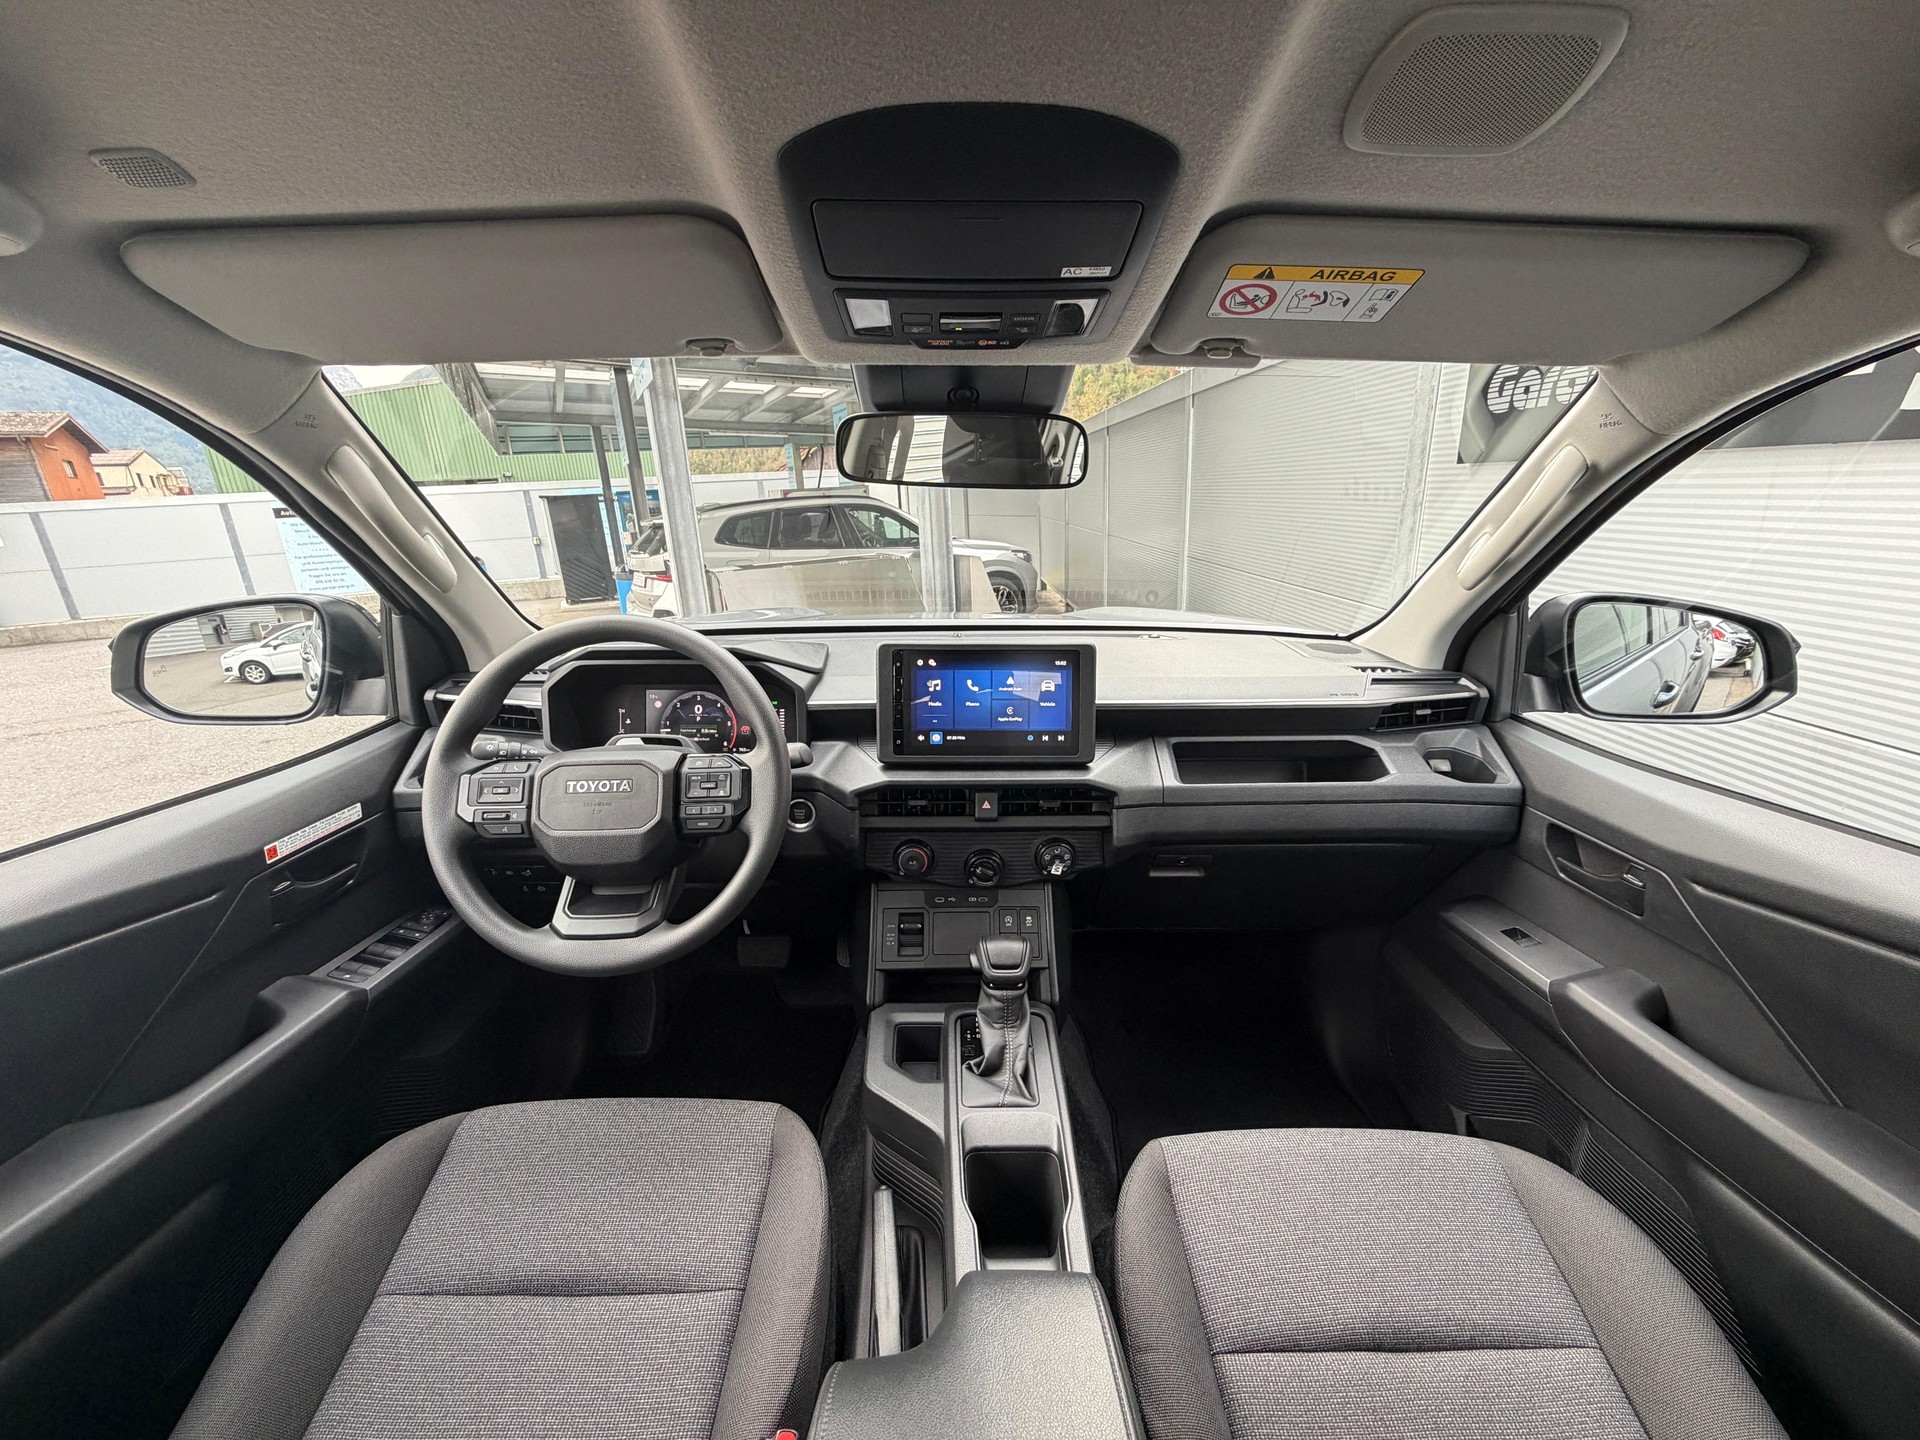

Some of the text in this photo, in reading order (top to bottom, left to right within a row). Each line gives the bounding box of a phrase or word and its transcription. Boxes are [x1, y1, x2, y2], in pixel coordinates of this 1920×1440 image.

[1063, 268, 1082, 276] AC
[1309, 269, 1397, 281] AIRBAG
[1487, 364, 1598, 414] Gara
[694, 704, 703, 714] 0
[567, 780, 631, 792] TOYOTA
